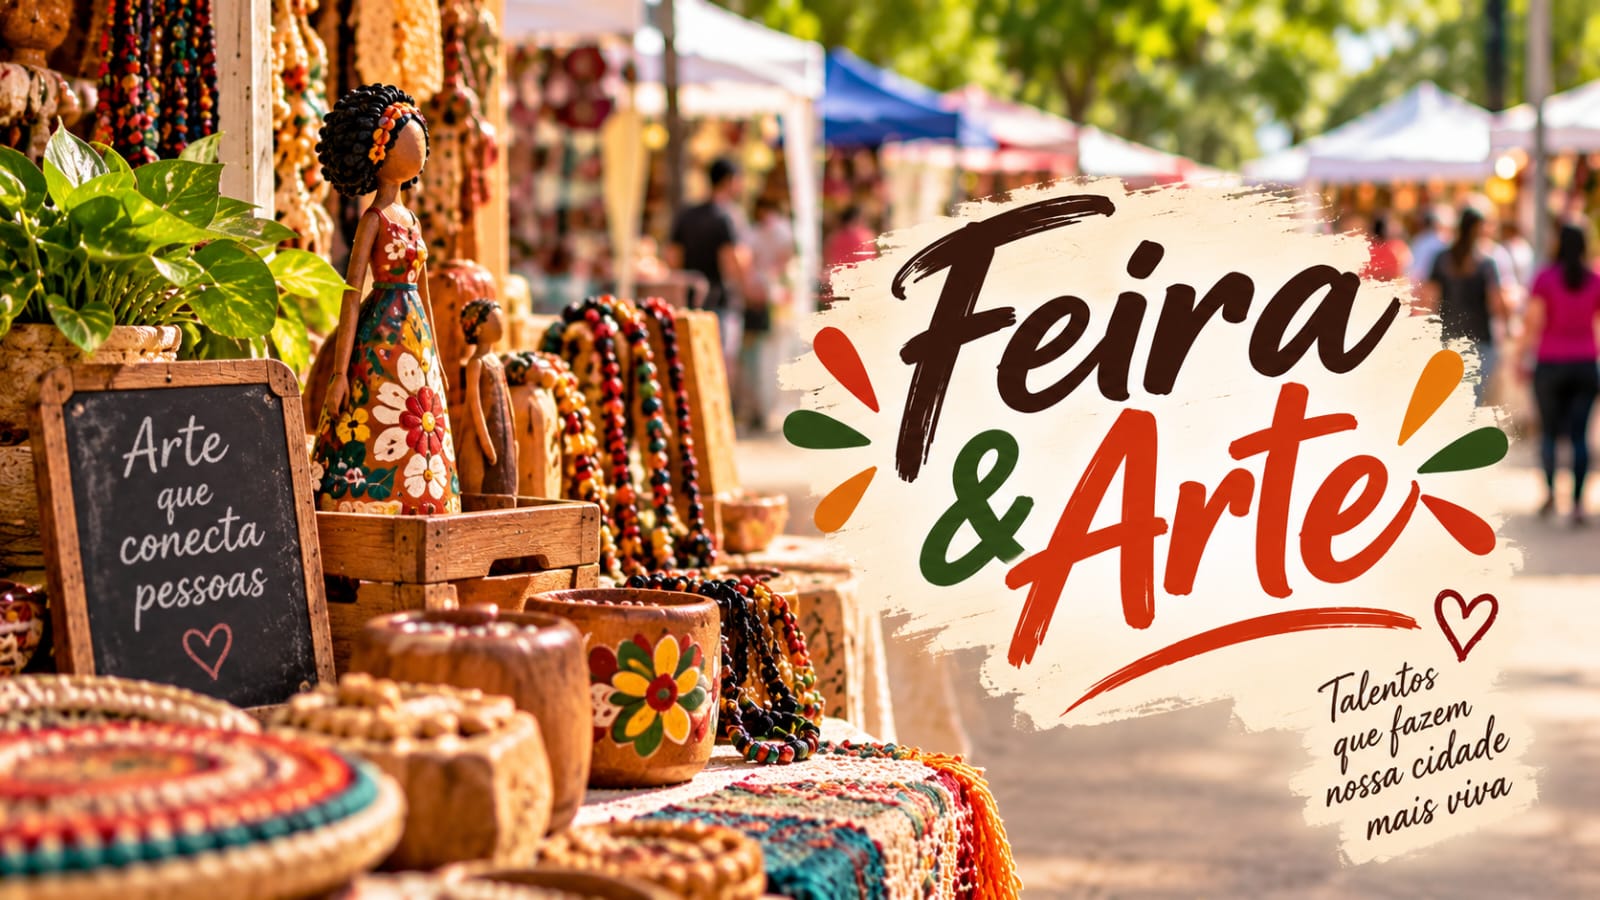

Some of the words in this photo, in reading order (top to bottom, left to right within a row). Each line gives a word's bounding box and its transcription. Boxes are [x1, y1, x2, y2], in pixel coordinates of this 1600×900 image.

[123, 415, 229, 478] Arte
[157, 483, 213, 525] que
[120, 506, 266, 565] conecta
[134, 567, 268, 632] pessoas
